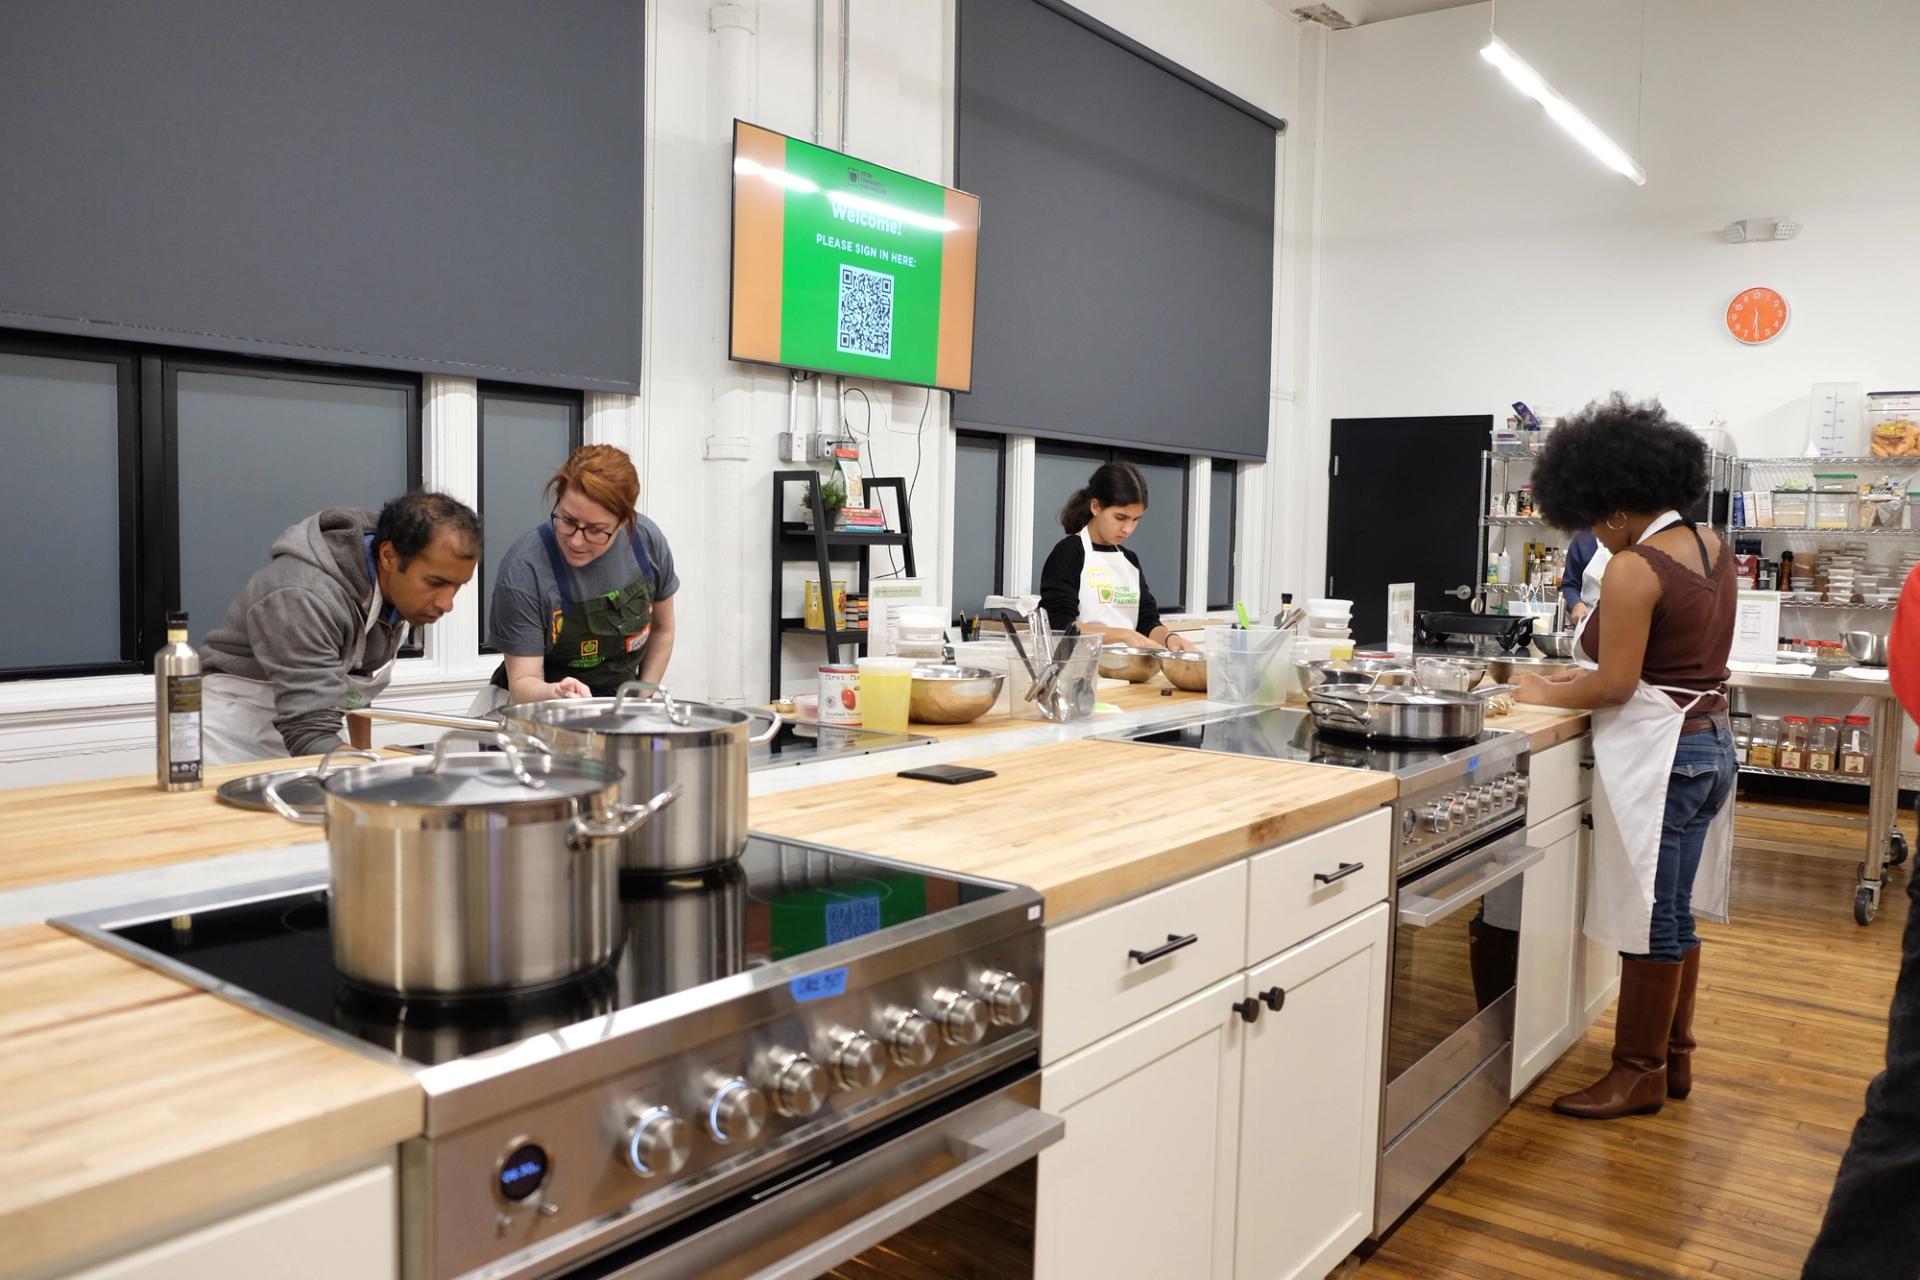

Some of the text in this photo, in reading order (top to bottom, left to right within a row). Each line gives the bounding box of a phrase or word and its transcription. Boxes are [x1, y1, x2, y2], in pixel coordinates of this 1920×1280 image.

[831, 201, 902, 236] Welcome!
[816, 232, 917, 268] PLEASE SIGN IN HERE:
